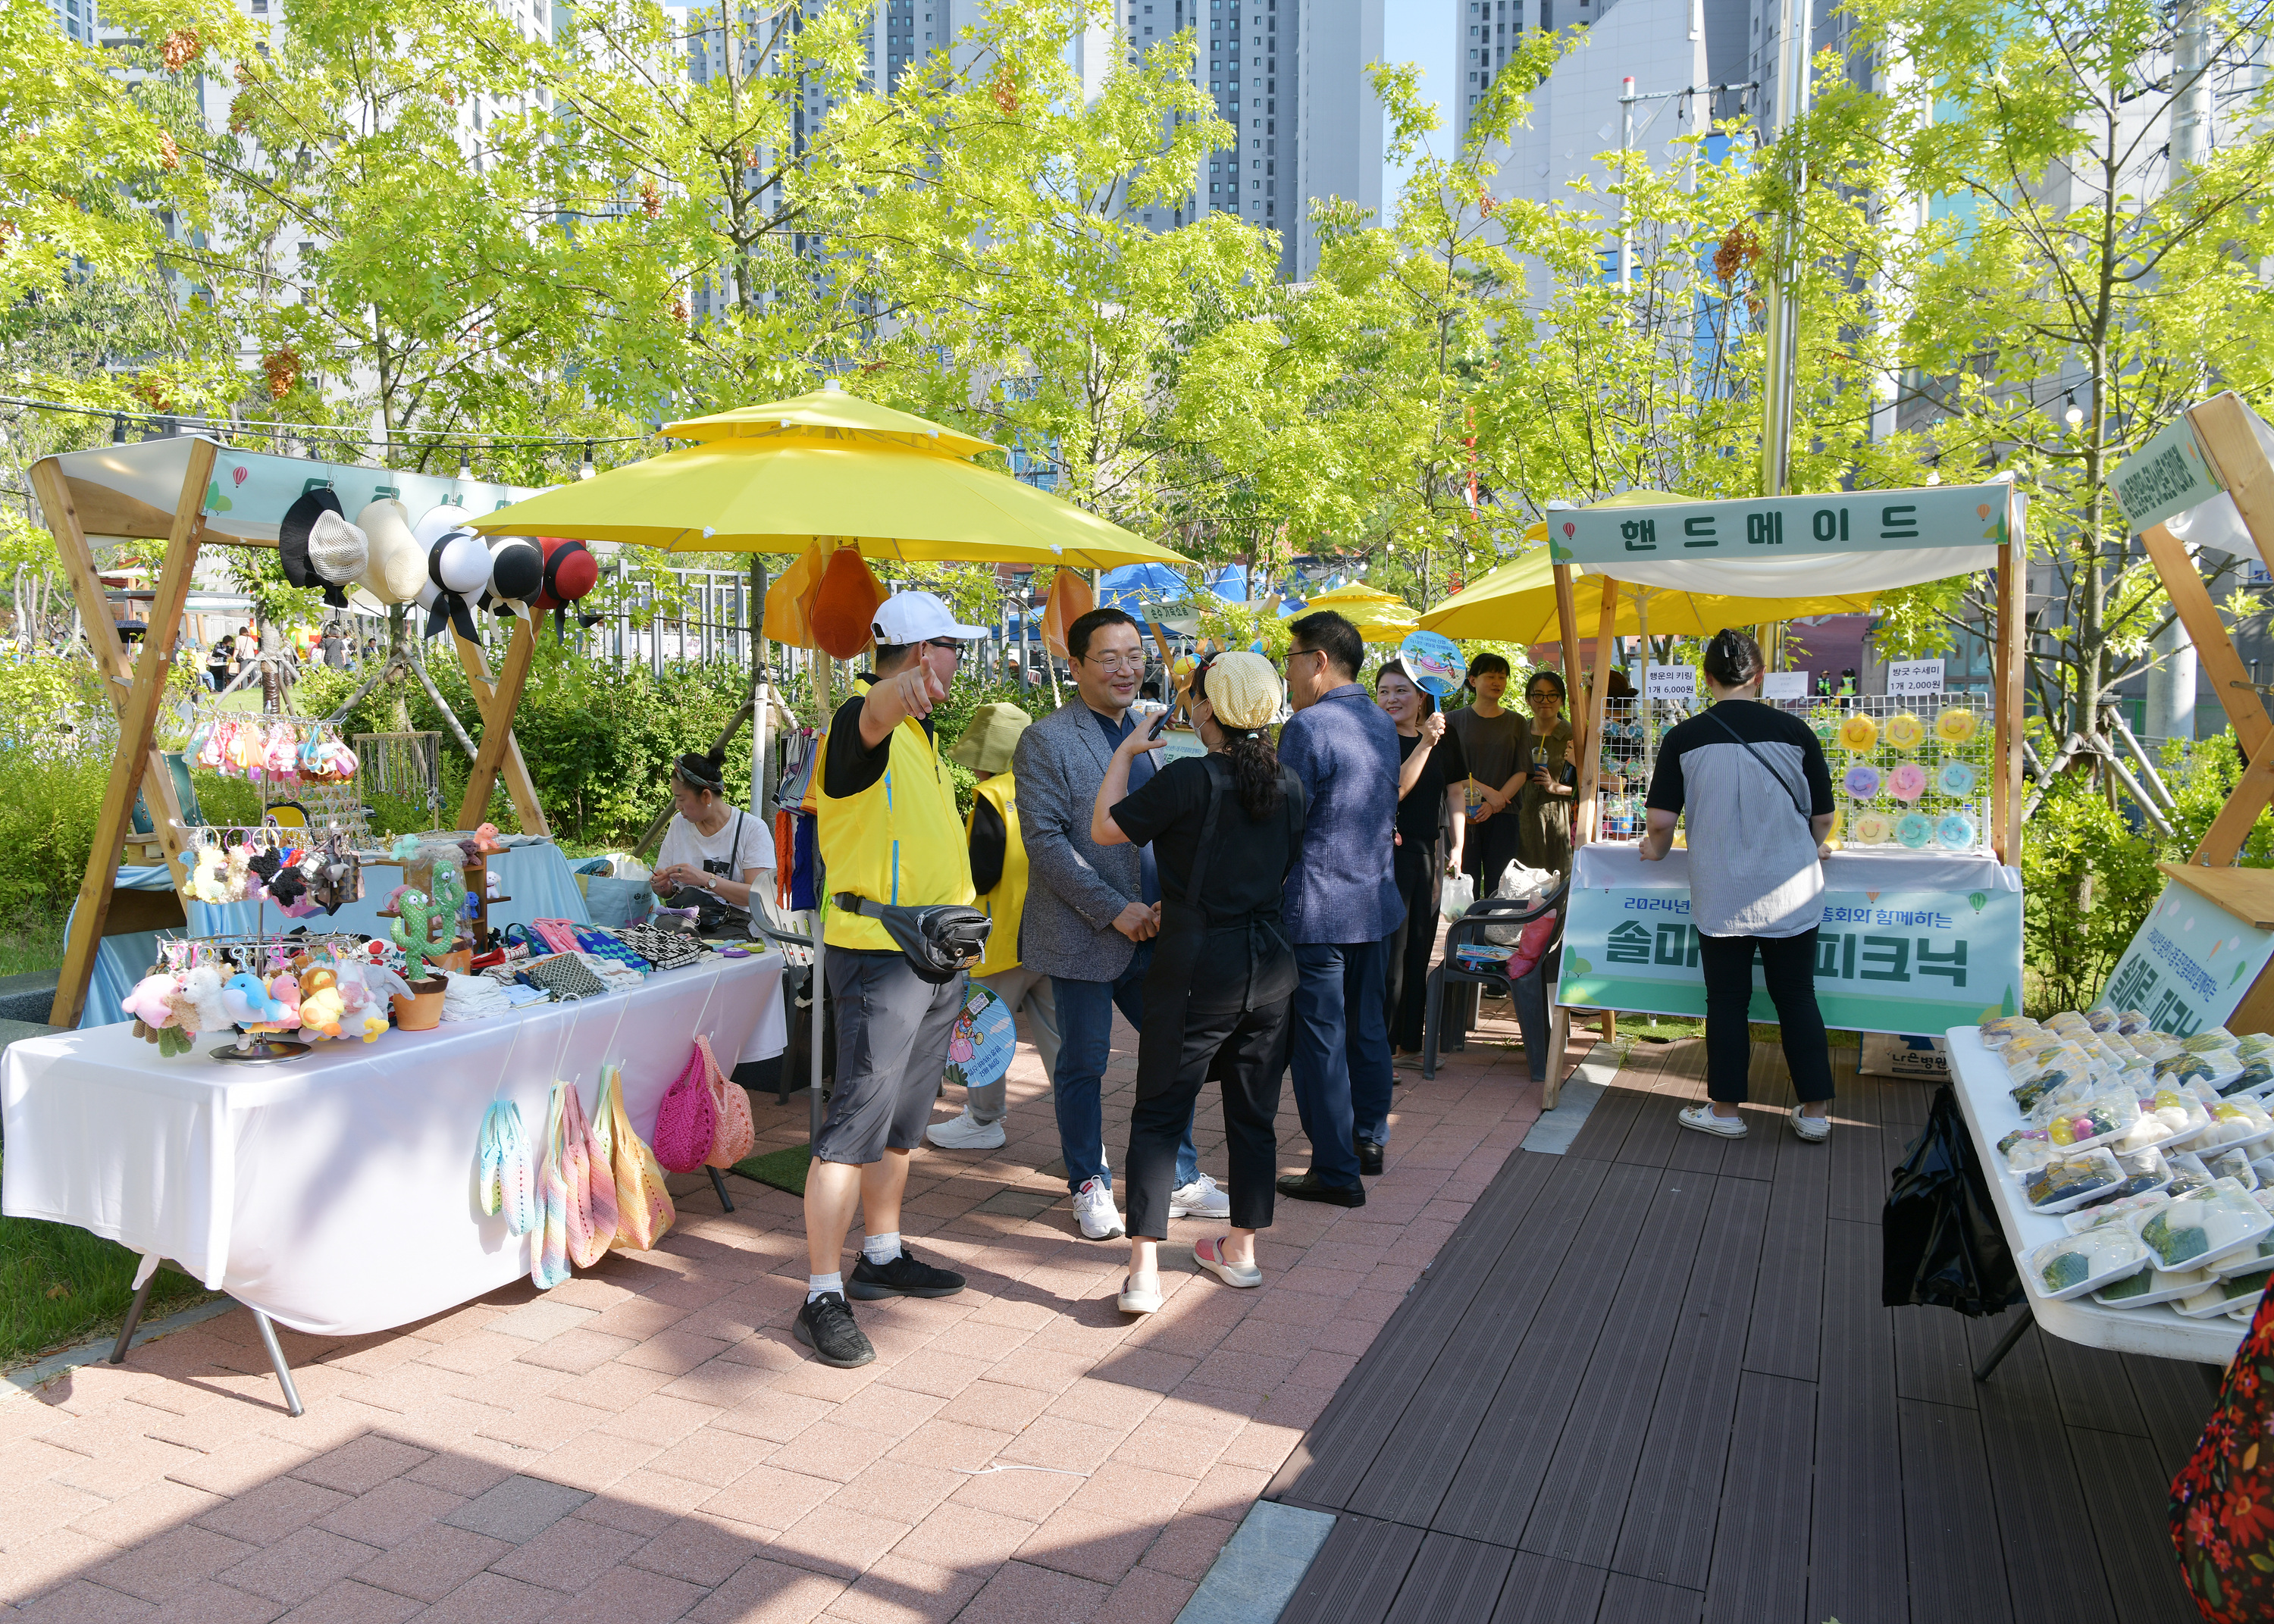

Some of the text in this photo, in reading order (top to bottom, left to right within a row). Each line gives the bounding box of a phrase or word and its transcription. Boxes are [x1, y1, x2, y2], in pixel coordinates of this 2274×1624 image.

[1621, 505, 1918, 552] 핸드메이드
[1649, 671, 1693, 681] 행운의 키링
[1893, 666, 1940, 677] 방긋 수세미
[1648, 685, 1694, 694] 1개 6,000원
[1890, 681, 1940, 690] 1개 2,000원
[1624, 897, 1690, 915] 2024년
[1876, 909, 1953, 929] 함께하는
[1606, 920, 1968, 987] 솔마 피크닉
[1893, 1052, 1947, 1069] 나은병원
